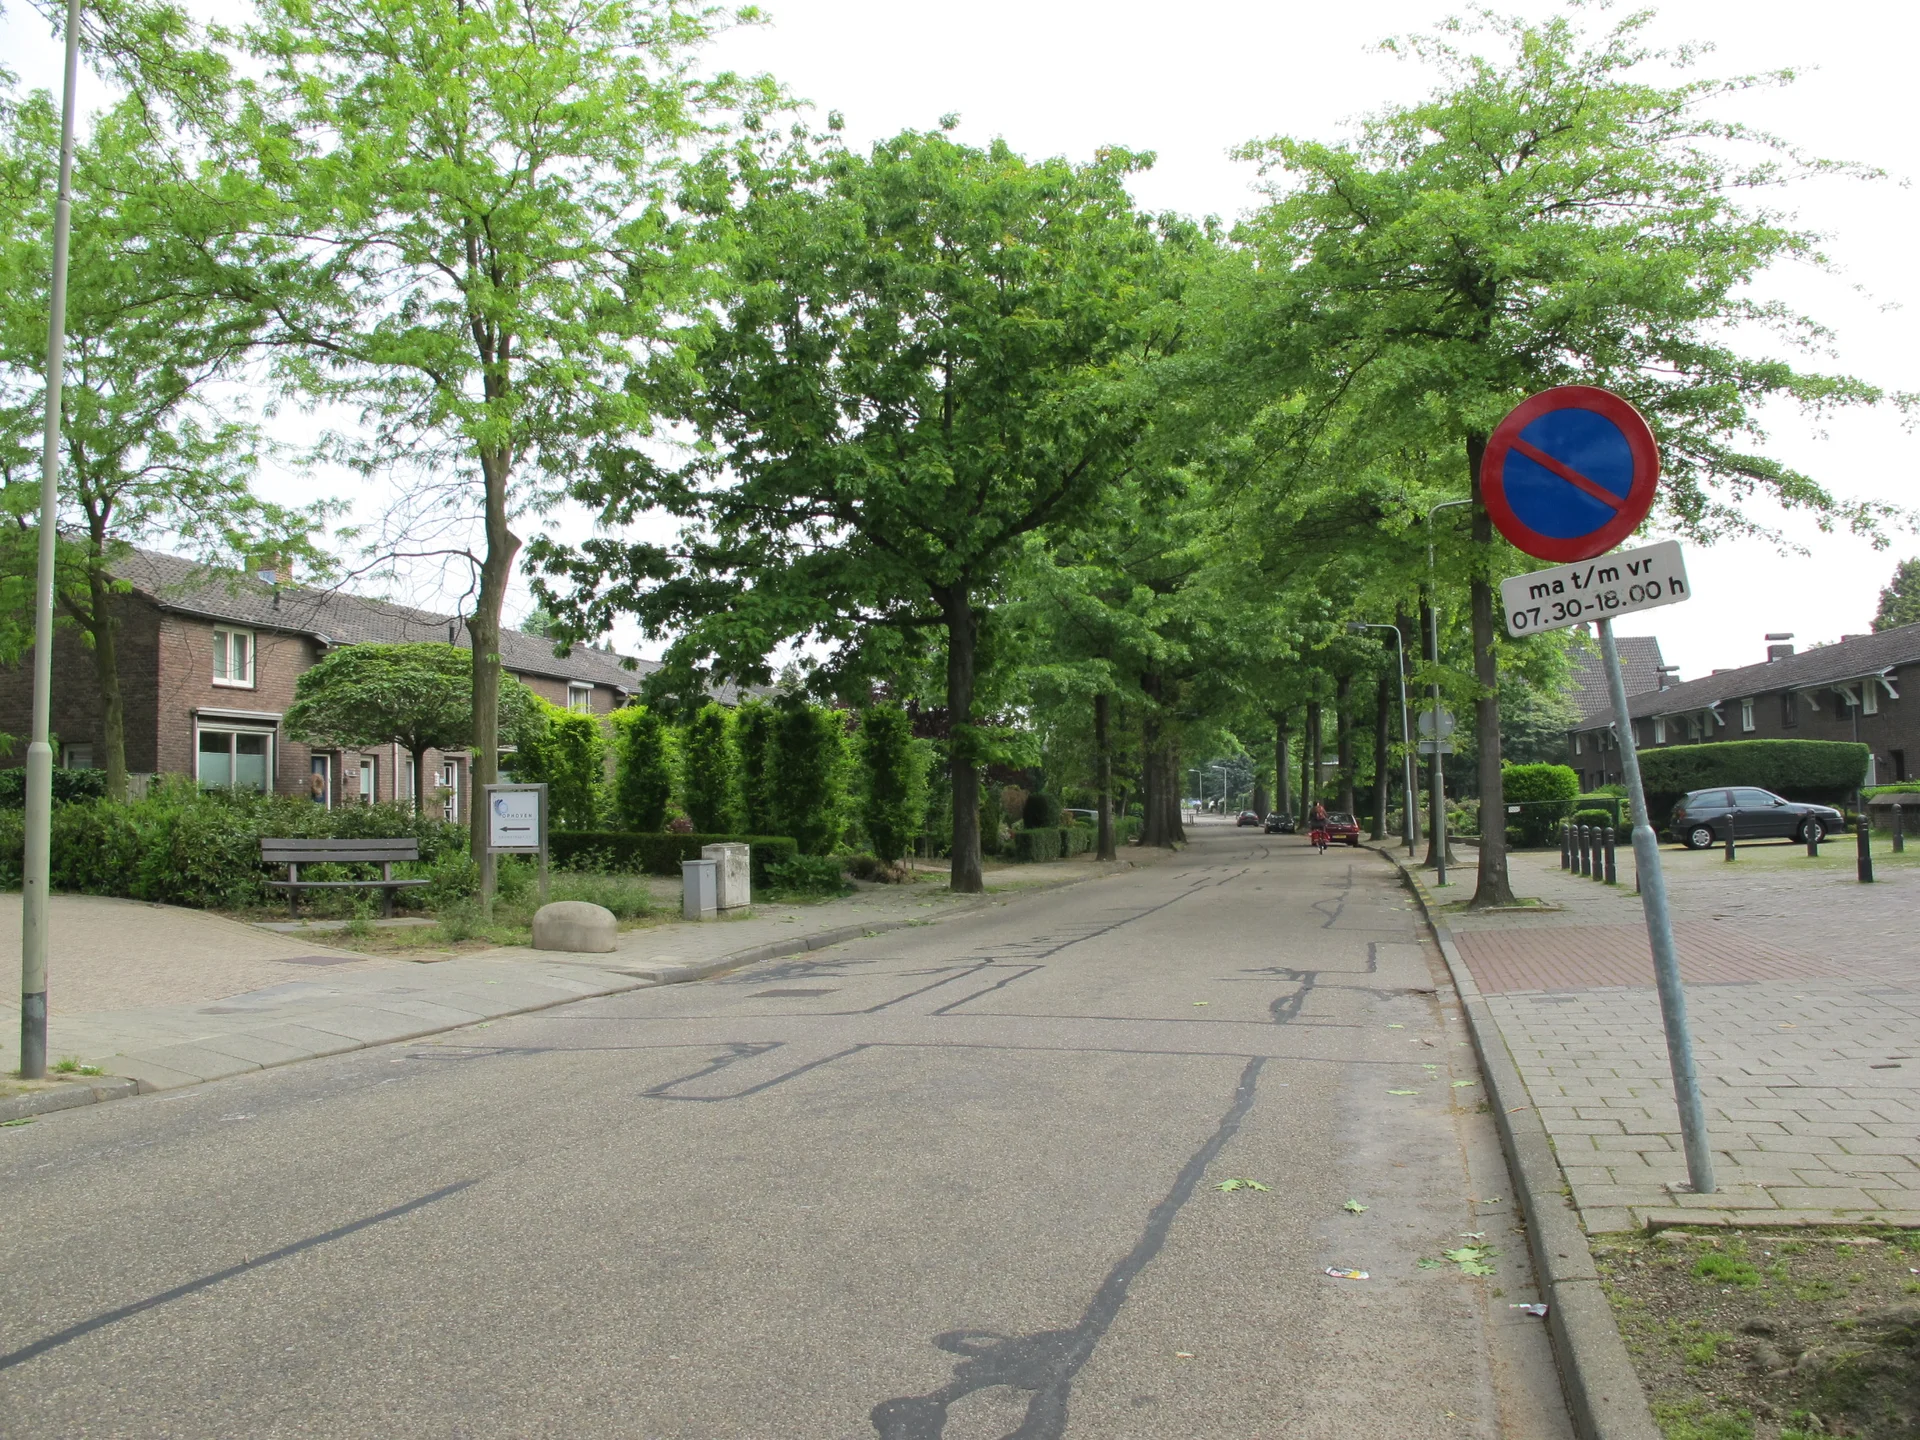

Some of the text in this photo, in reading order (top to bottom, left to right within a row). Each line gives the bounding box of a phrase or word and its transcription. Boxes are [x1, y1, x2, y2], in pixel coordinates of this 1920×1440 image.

[1512, 576, 1684, 630] 07.30-18.00 h
[1529, 558, 1653, 600] ma t/m vr
